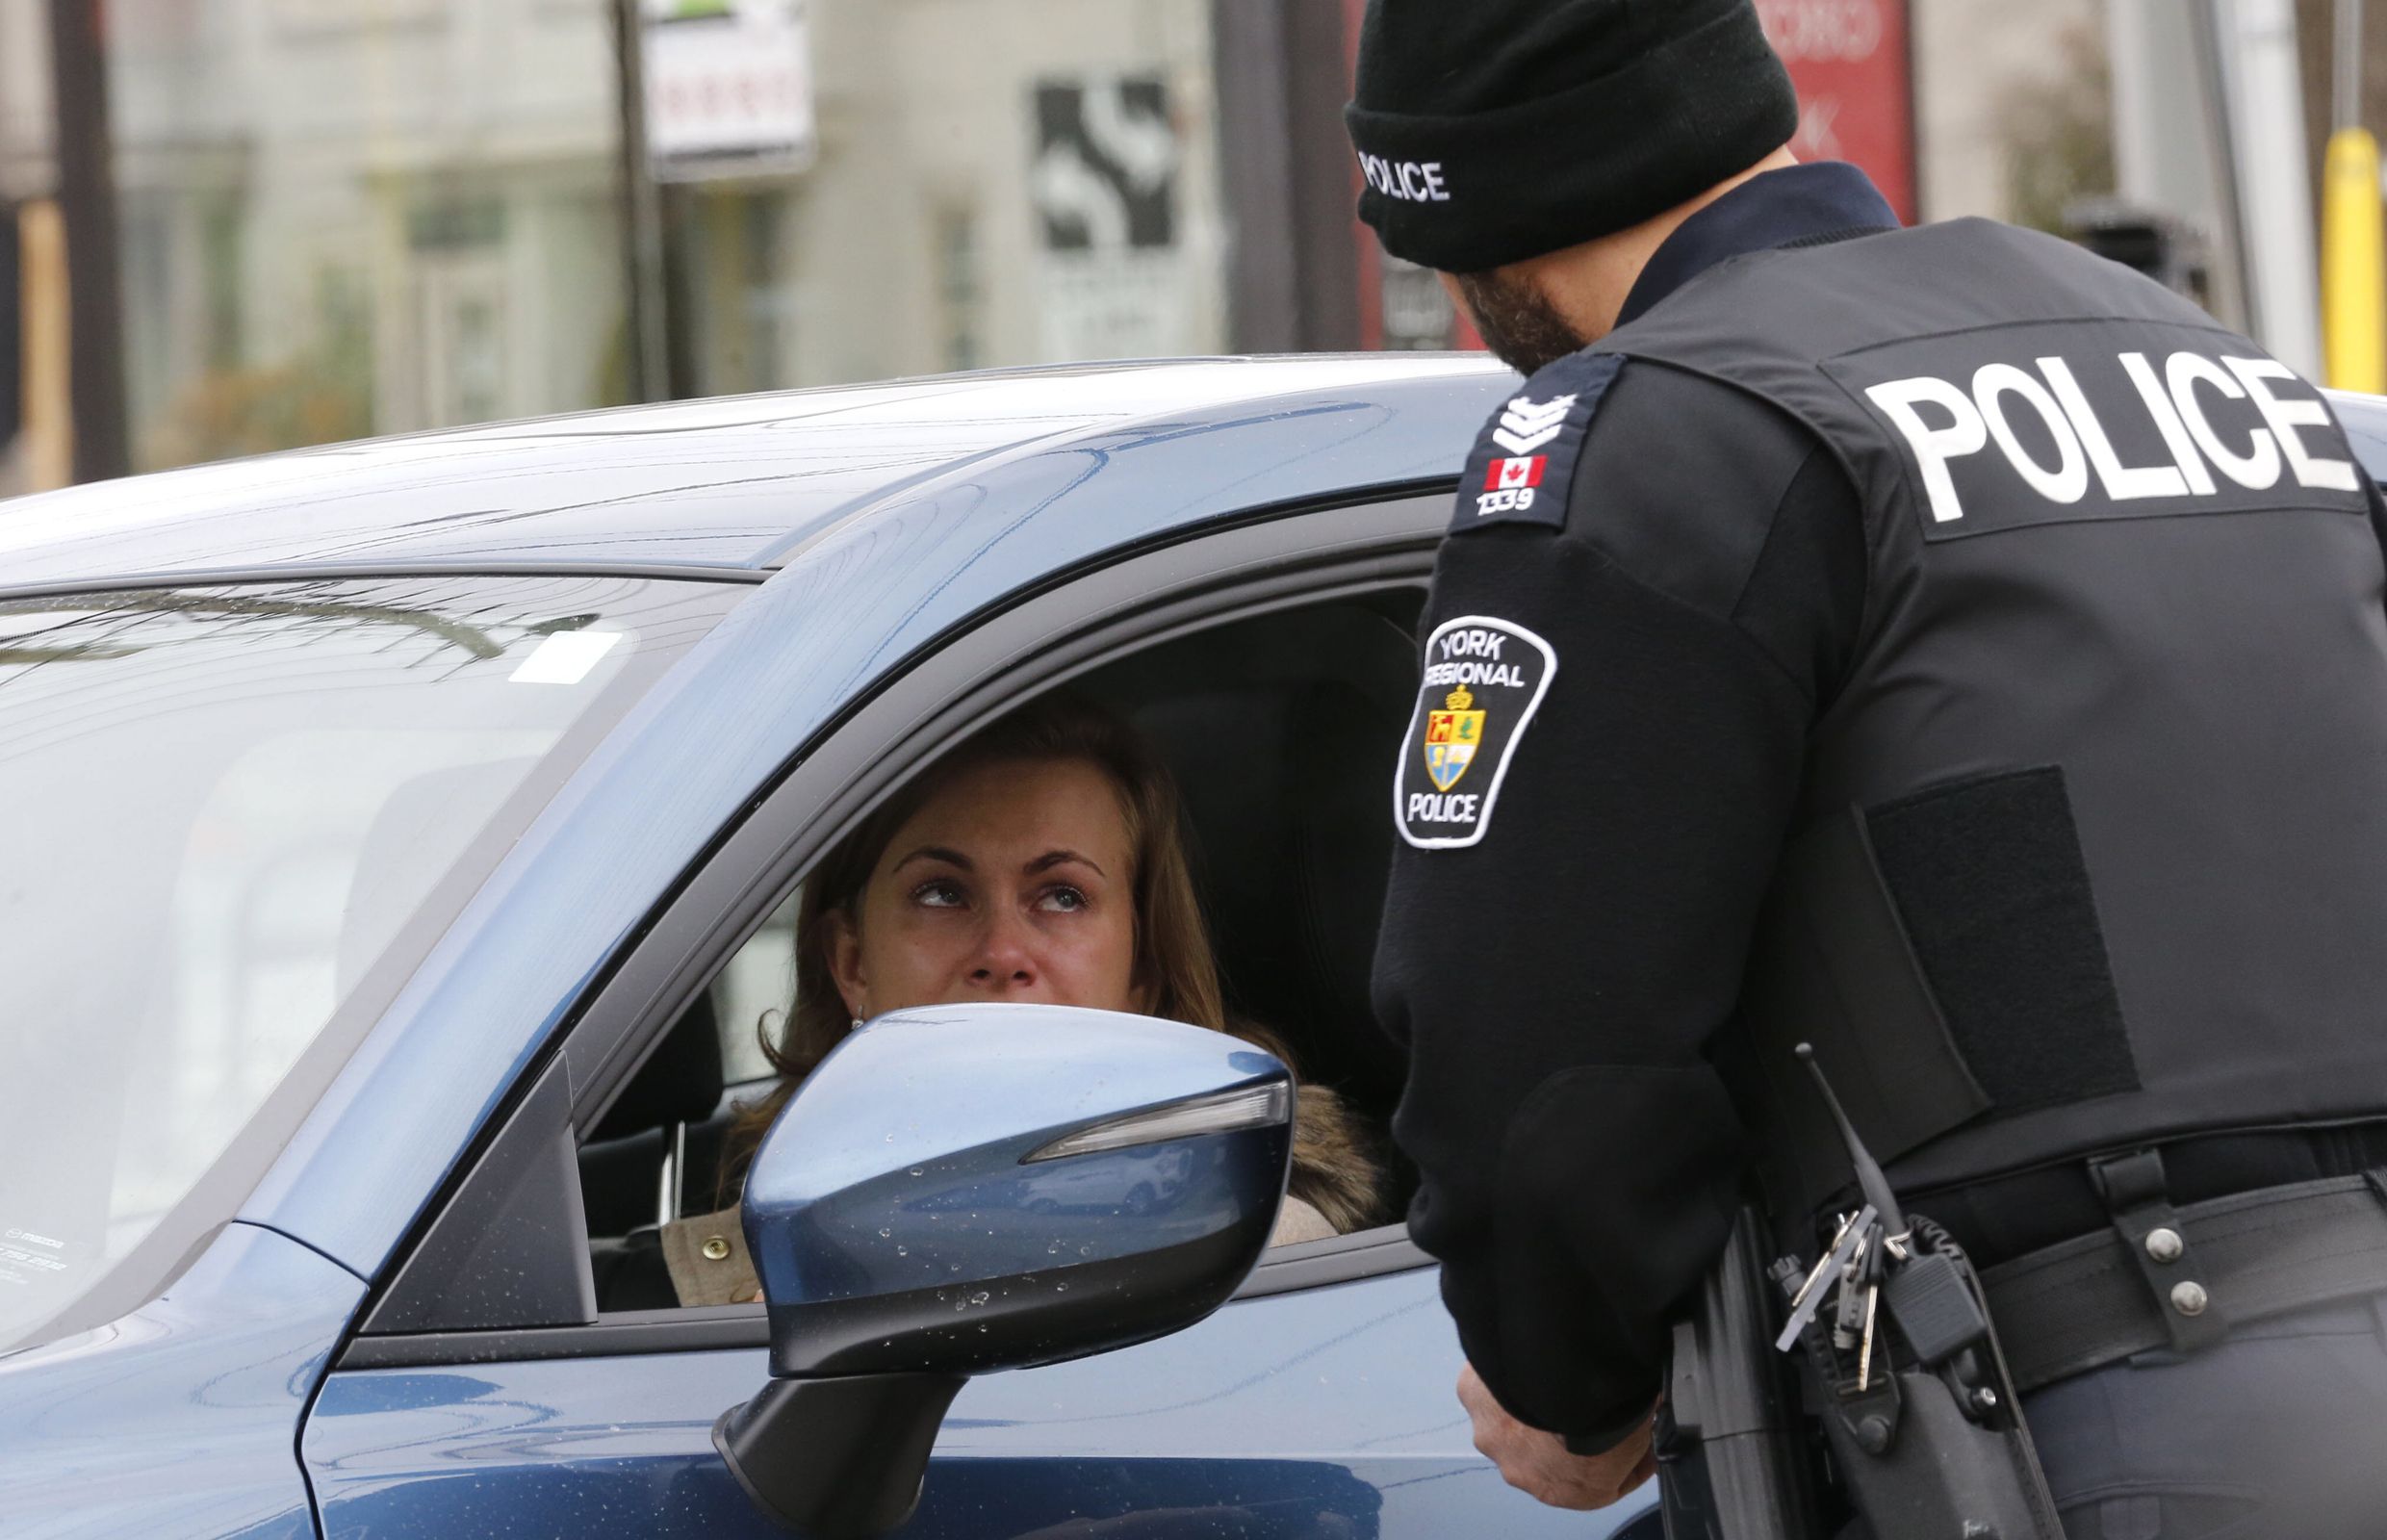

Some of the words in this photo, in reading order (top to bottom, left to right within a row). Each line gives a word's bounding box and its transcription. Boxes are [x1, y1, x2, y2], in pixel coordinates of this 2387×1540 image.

[1358, 151, 1450, 202] POLICE
[1864, 350, 2359, 523] POLICE
[1476, 487, 1534, 516] 1339
[1440, 629, 1506, 660] YORK
[1406, 792, 1479, 823] POLICE
